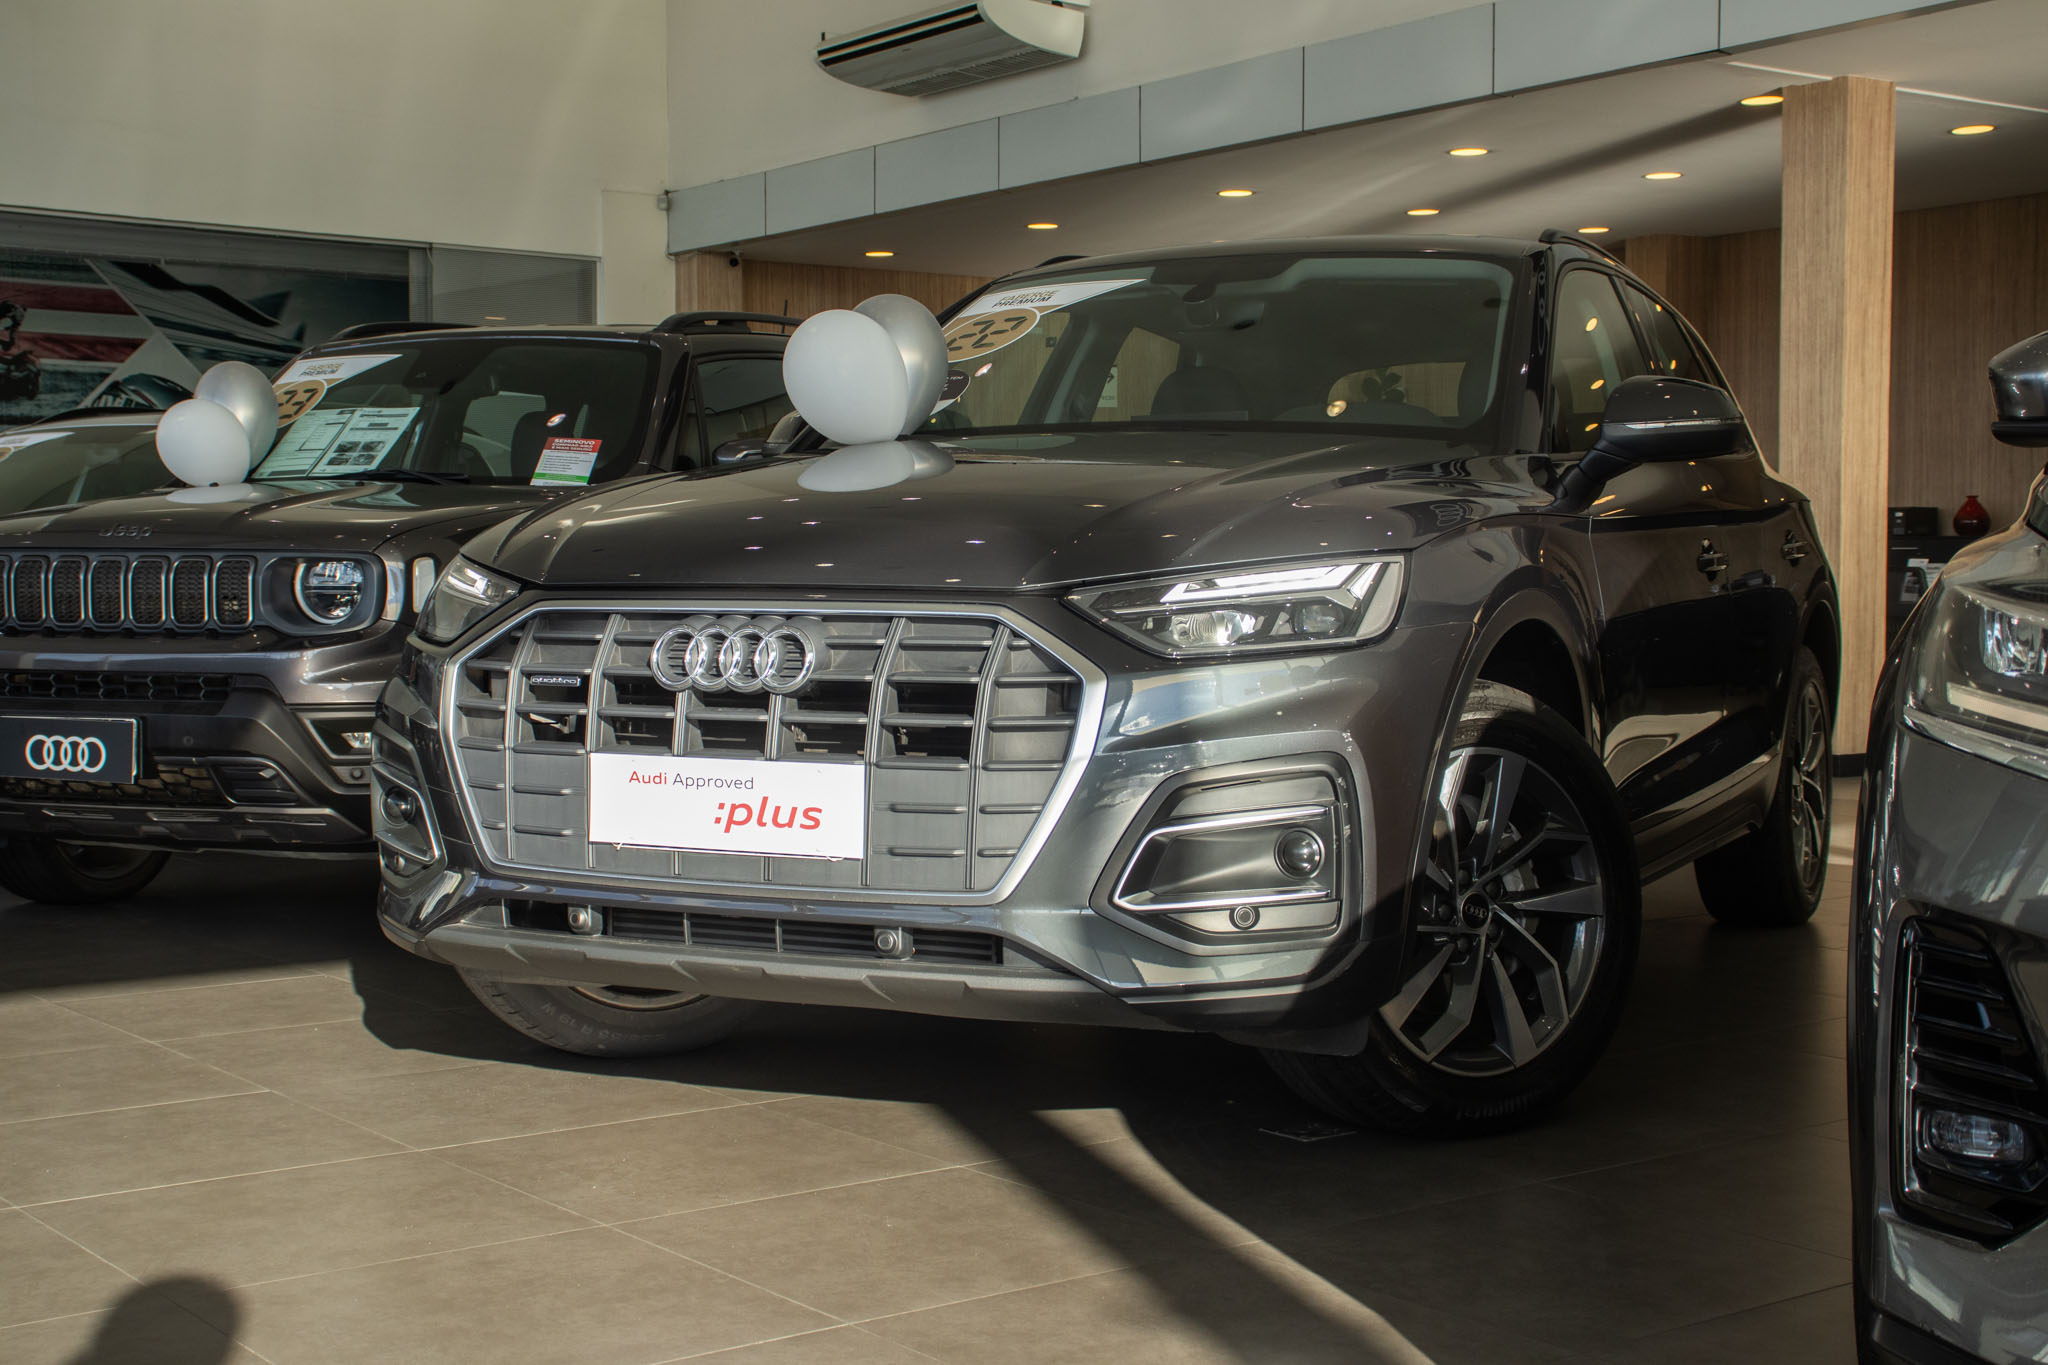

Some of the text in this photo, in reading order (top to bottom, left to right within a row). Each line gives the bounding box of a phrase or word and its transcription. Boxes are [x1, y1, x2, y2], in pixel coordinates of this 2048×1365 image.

[992, 296, 1051, 308] PREMIUM
[98, 523, 153, 540] Jeep
[629, 771, 754, 790] Audi Approved
